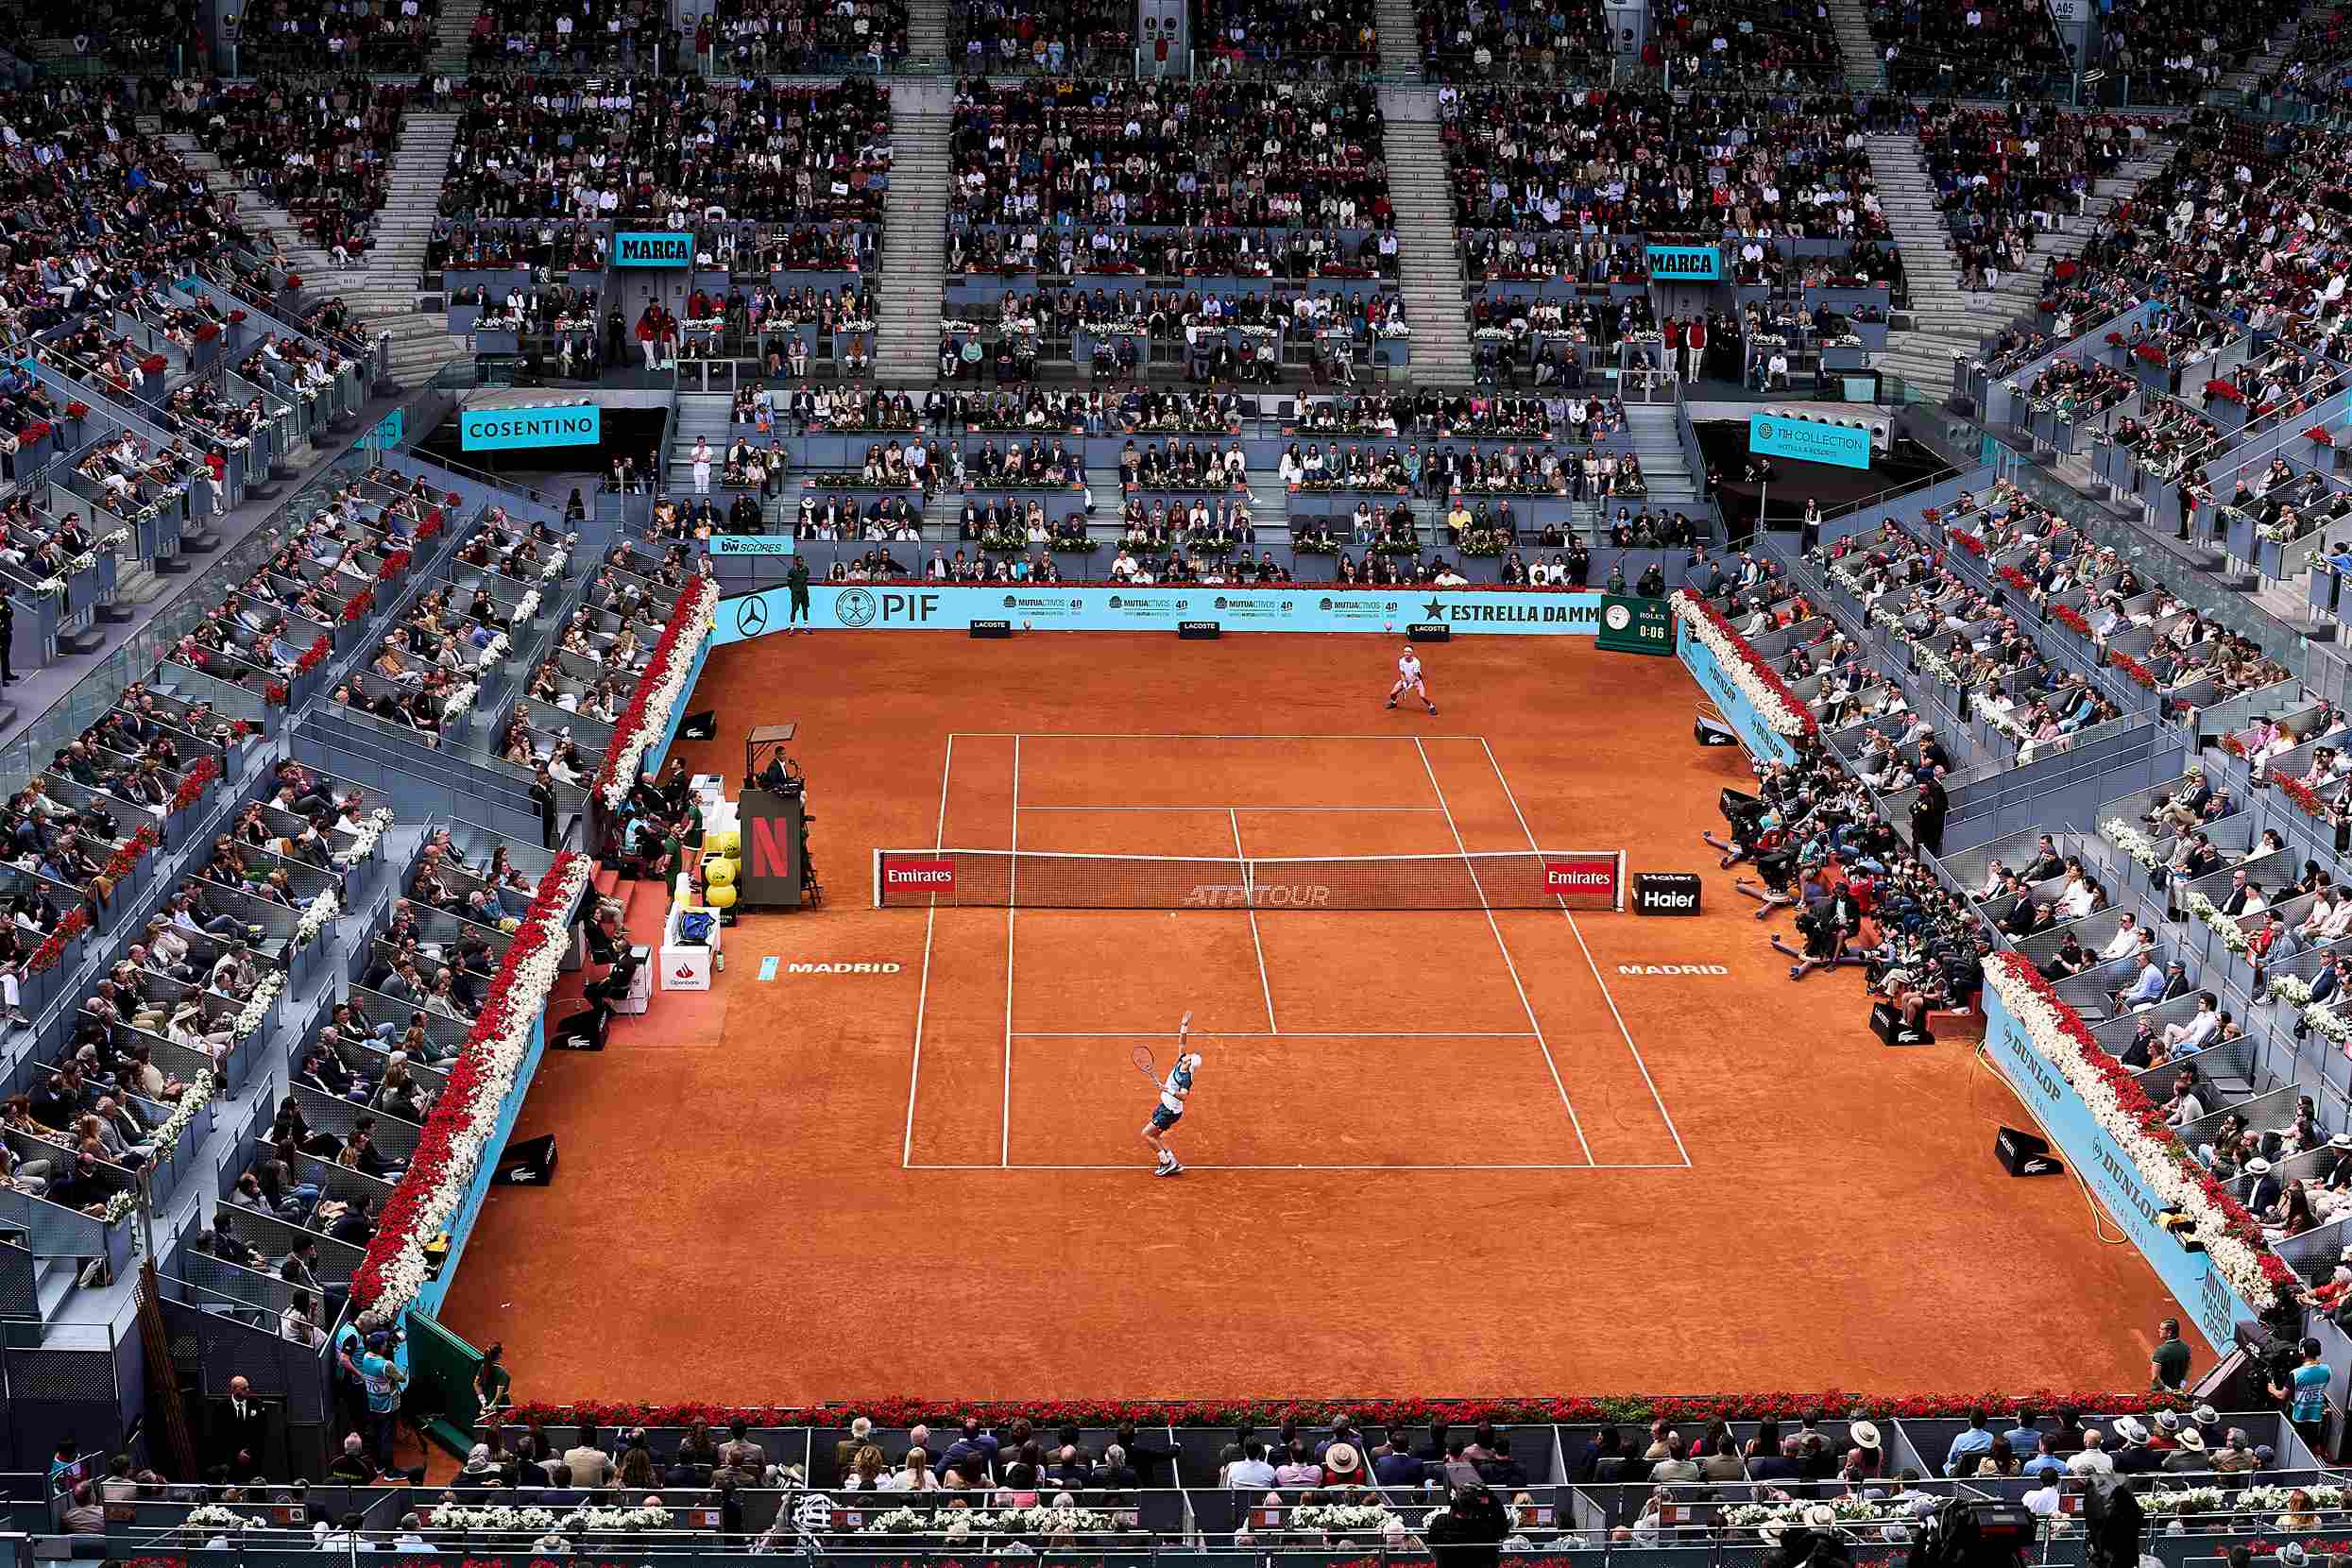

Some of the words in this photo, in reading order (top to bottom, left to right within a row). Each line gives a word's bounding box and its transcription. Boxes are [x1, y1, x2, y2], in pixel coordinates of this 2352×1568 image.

[2055, 3, 2073, 14] A05
[622, 240, 689, 260] MARCA
[1648, 253, 1713, 273] MARCA
[469, 418, 592, 438] COSENTINO
[1794, 430, 1863, 450] COLLECTION
[741, 543, 782, 553] SCORES
[881, 594, 940, 622] PIF
[1069, 599, 1082, 608] 40
[1175, 600, 1188, 608] 40
[1281, 601, 1293, 609] 40
[1385, 602, 1398, 611] 40
[1450, 605, 1539, 622] ESTRELLA
[1542, 605, 1600, 622] DAMM
[1640, 624, 1664, 639] 0:06
[1713, 667, 1737, 703] DUNLOP
[751, 817, 787, 878] N
[888, 869, 952, 883] Emirates
[1548, 871, 1611, 885] Emirates
[1252, 884, 1331, 906] TOUR
[1644, 891, 1696, 908] Haier
[788, 963, 900, 974] MADRID
[1617, 964, 1729, 975] MADRID
[2011, 1039, 2062, 1101] DUNLOP
[1999, 1132, 2016, 1156] LACOSTE
[2102, 1151, 2159, 1227] DUNLOP
[2205, 1267, 2231, 1316] MUTUA
[2201, 1287, 2231, 1336] MADRID
